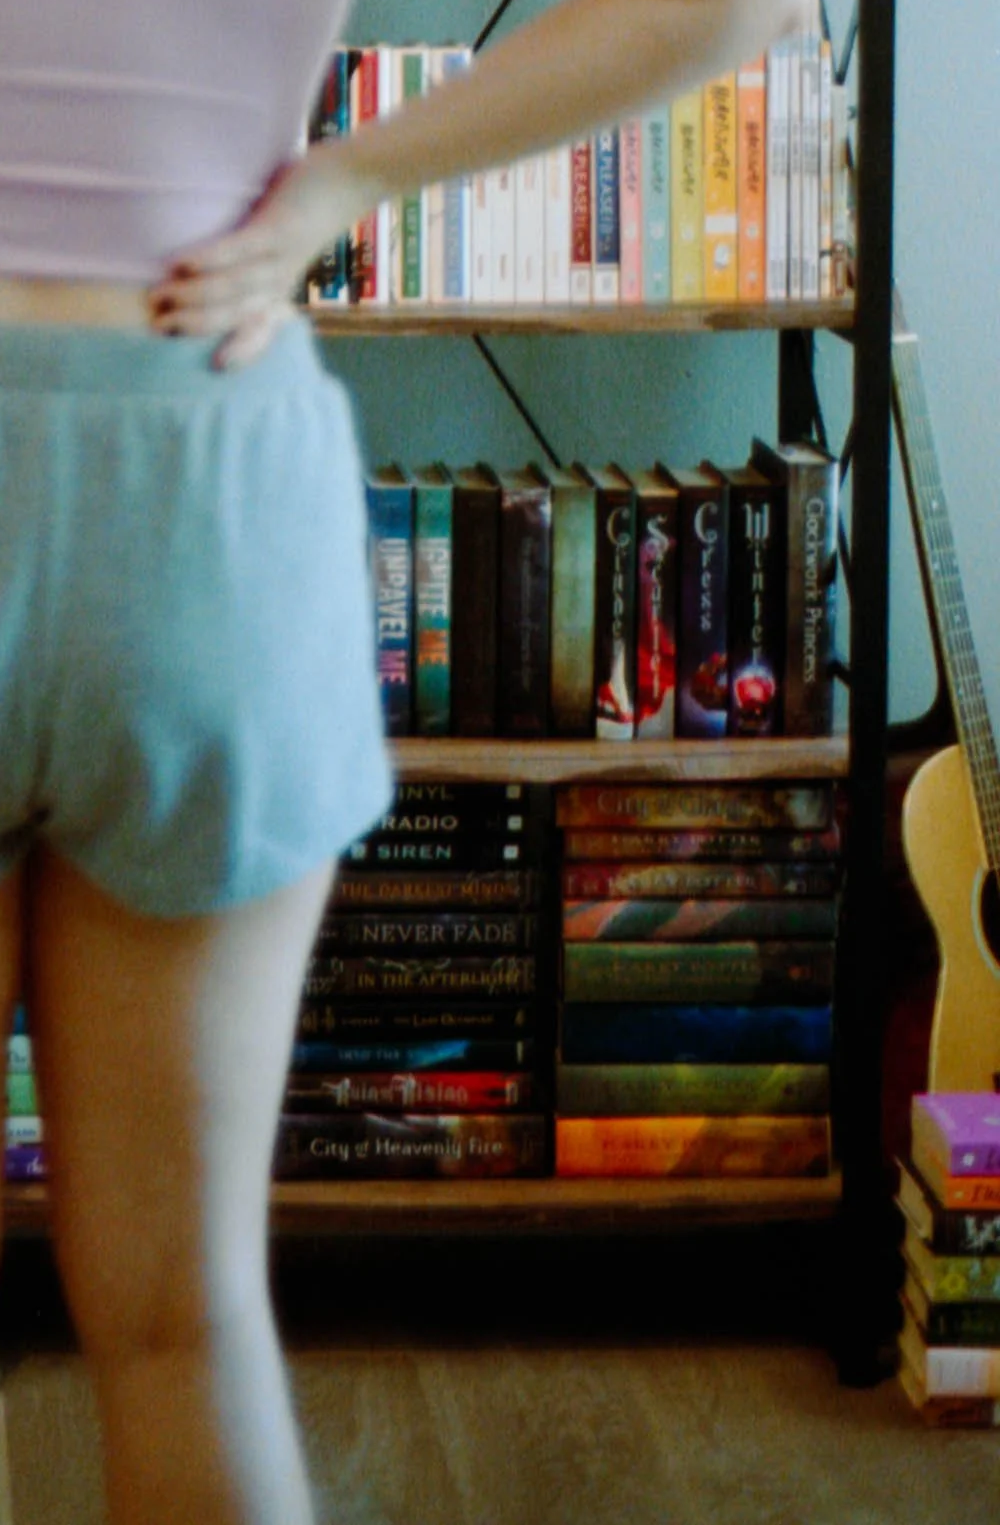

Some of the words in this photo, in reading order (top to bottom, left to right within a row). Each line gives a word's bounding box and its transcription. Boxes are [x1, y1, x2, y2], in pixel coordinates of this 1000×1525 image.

[694, 502, 719, 632] Cress
[804, 498, 824, 600] Clockwork
[378, 537, 407, 644] UNRAVEL
[418, 537, 449, 618] IGNITE
[418, 629, 449, 666] ME
[803, 607, 822, 684] Princess
[378, 649, 407, 685] ME
[399, 784, 455, 801] INYL
[381, 814, 460, 831] RADIO
[376, 843, 453, 860] SIREN
[361, 924, 445, 943] NEVER
[453, 924, 517, 943] FADE
[357, 973, 375, 987] IN
[309, 1139, 349, 1163] City
[375, 1138, 463, 1160] Heavenly
